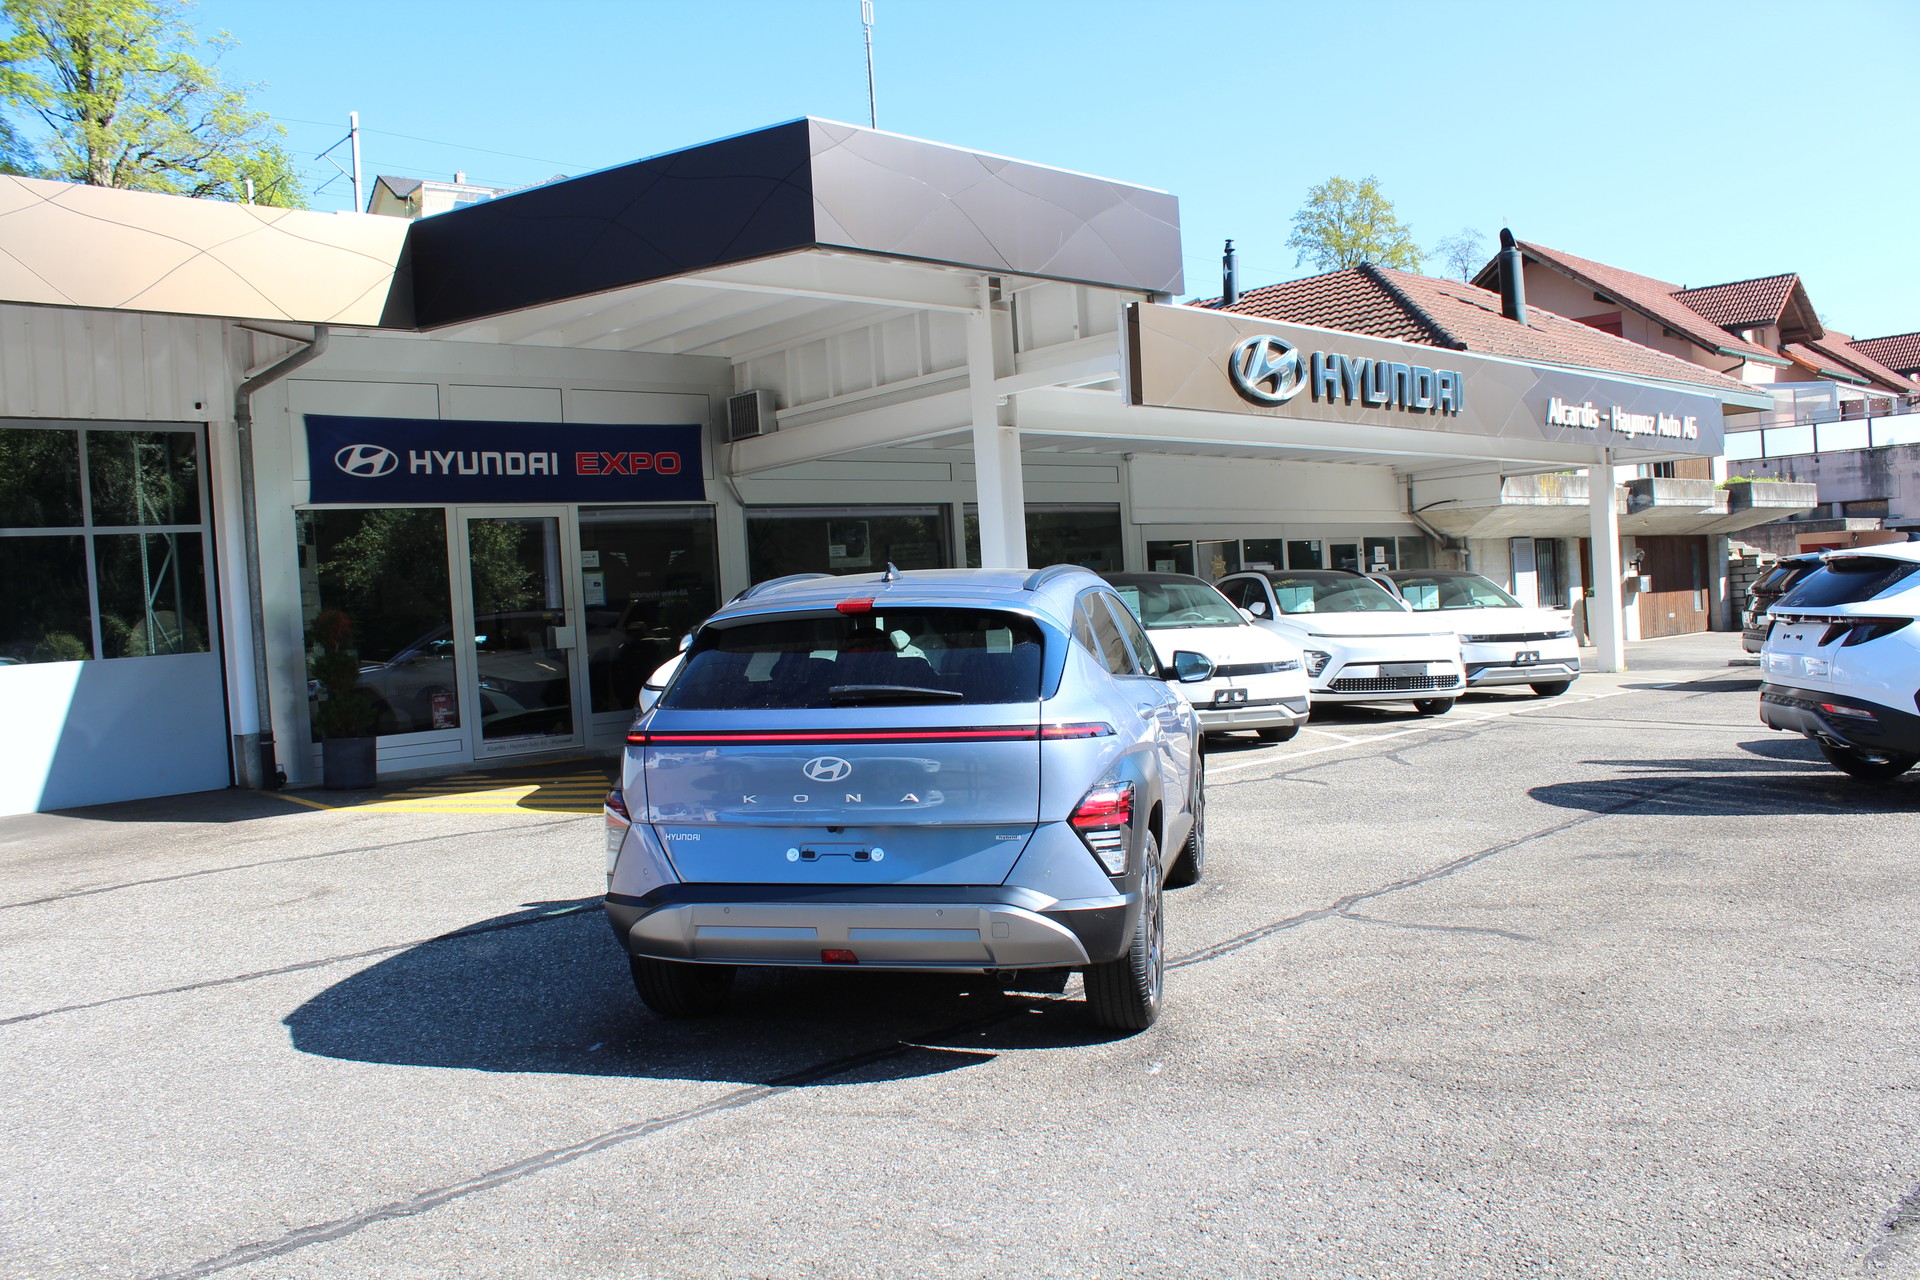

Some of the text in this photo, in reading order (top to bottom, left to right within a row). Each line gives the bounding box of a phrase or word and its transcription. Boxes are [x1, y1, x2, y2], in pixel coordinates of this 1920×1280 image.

[1311, 350, 1464, 412] HYUNDAI
[1549, 397, 1599, 428] Alcardis
[1611, 405, 1656, 439] Haymoz
[1656, 412, 1681, 438] Auto
[1682, 416, 1698, 440] AG
[409, 450, 682, 475] HYUNDAI EXPO
[743, 793, 920, 804] KONA
[665, 833, 701, 841] HYUNDAI
